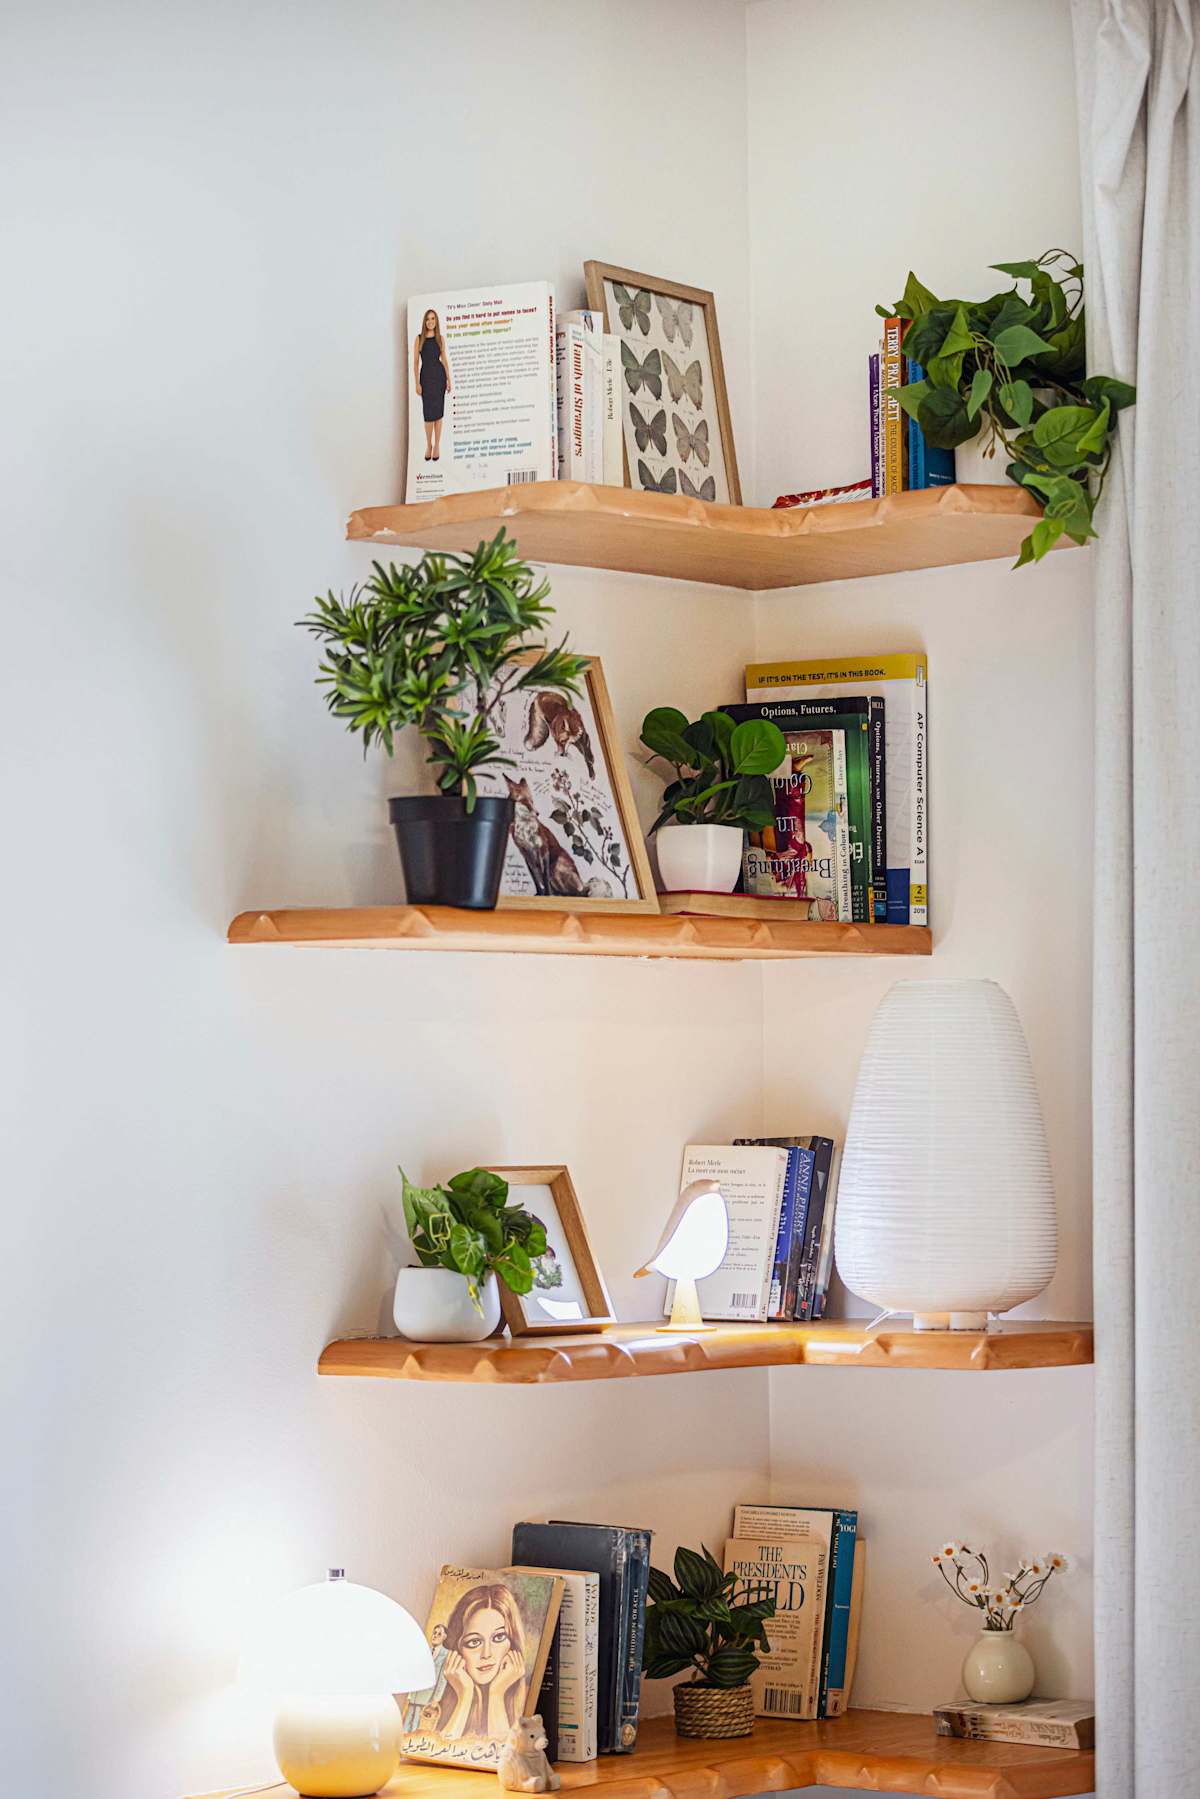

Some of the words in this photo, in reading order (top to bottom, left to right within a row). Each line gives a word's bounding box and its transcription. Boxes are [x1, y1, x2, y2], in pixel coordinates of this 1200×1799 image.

[887, 327, 900, 358] TERRY
[574, 343, 584, 381] Family
[574, 383, 584, 396] of
[887, 362, 900, 422] PRATHETT
[574, 397, 584, 457] Strangers
[758, 676, 766, 684] IF
[766, 675, 780, 683] IT'S
[781, 674, 791, 682] ON
[793, 673, 807, 681] THE
[808, 673, 826, 681] TEST,
[826, 672, 839, 680] IT'S
[839, 671, 847, 679] IN
[848, 670, 863, 678] THIS
[864, 669, 886, 677] BOOK.
[760, 705, 799, 719] Options,
[916, 712, 924, 726] AP
[786, 742, 808, 755] Clar
[916, 728, 924, 794] Computer
[774, 774, 812, 795] Colo
[776, 816, 797, 832] in
[916, 796, 924, 844] Science
[840, 829, 849, 858] Colour
[916, 847, 924, 856] A
[747, 852, 832, 881] Breathing
[841, 869, 850, 913] Breathing
[917, 886, 922, 894] 2
[800, 1154, 811, 1193] ANNE
[796, 1196, 808, 1236] PERRY
[839, 1525, 856, 1533] YOGI
[758, 1545, 783, 1562] THE
[732, 1562, 807, 1580] PRESIDENT'S
[815, 1568, 824, 1601] WELDON
[631, 1588, 640, 1621] ORACLE
[628, 1656, 636, 1672] THE
